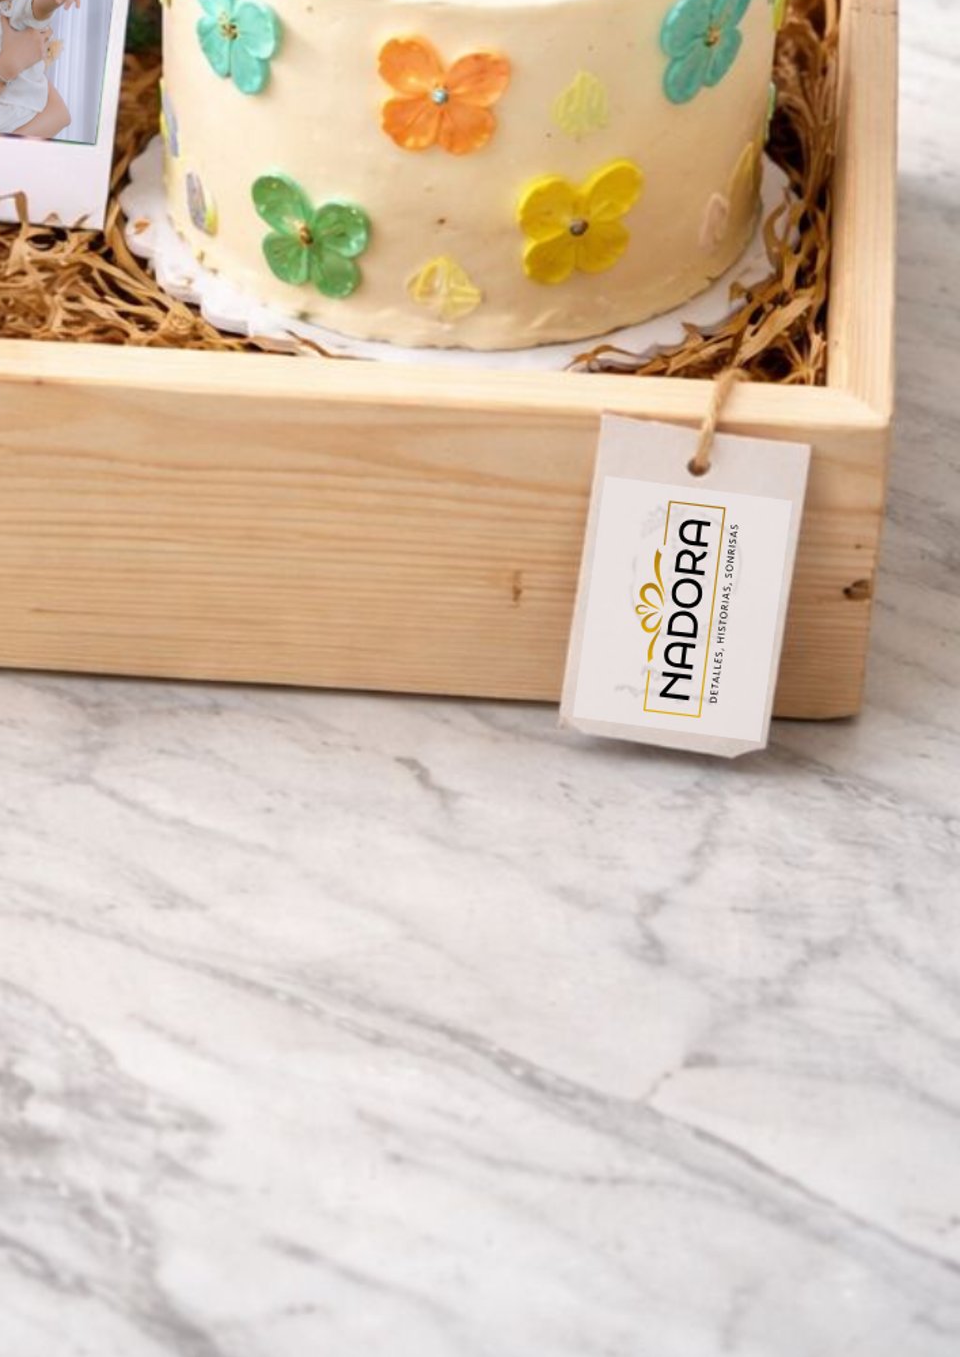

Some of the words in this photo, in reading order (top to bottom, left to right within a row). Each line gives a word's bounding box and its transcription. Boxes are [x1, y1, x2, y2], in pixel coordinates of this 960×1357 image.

[659, 519, 711, 701] NADORA
[710, 648, 724, 703] DETALLES,
[717, 583, 732, 644] HISTORIAS,
[725, 524, 739, 578] SONRISAS
